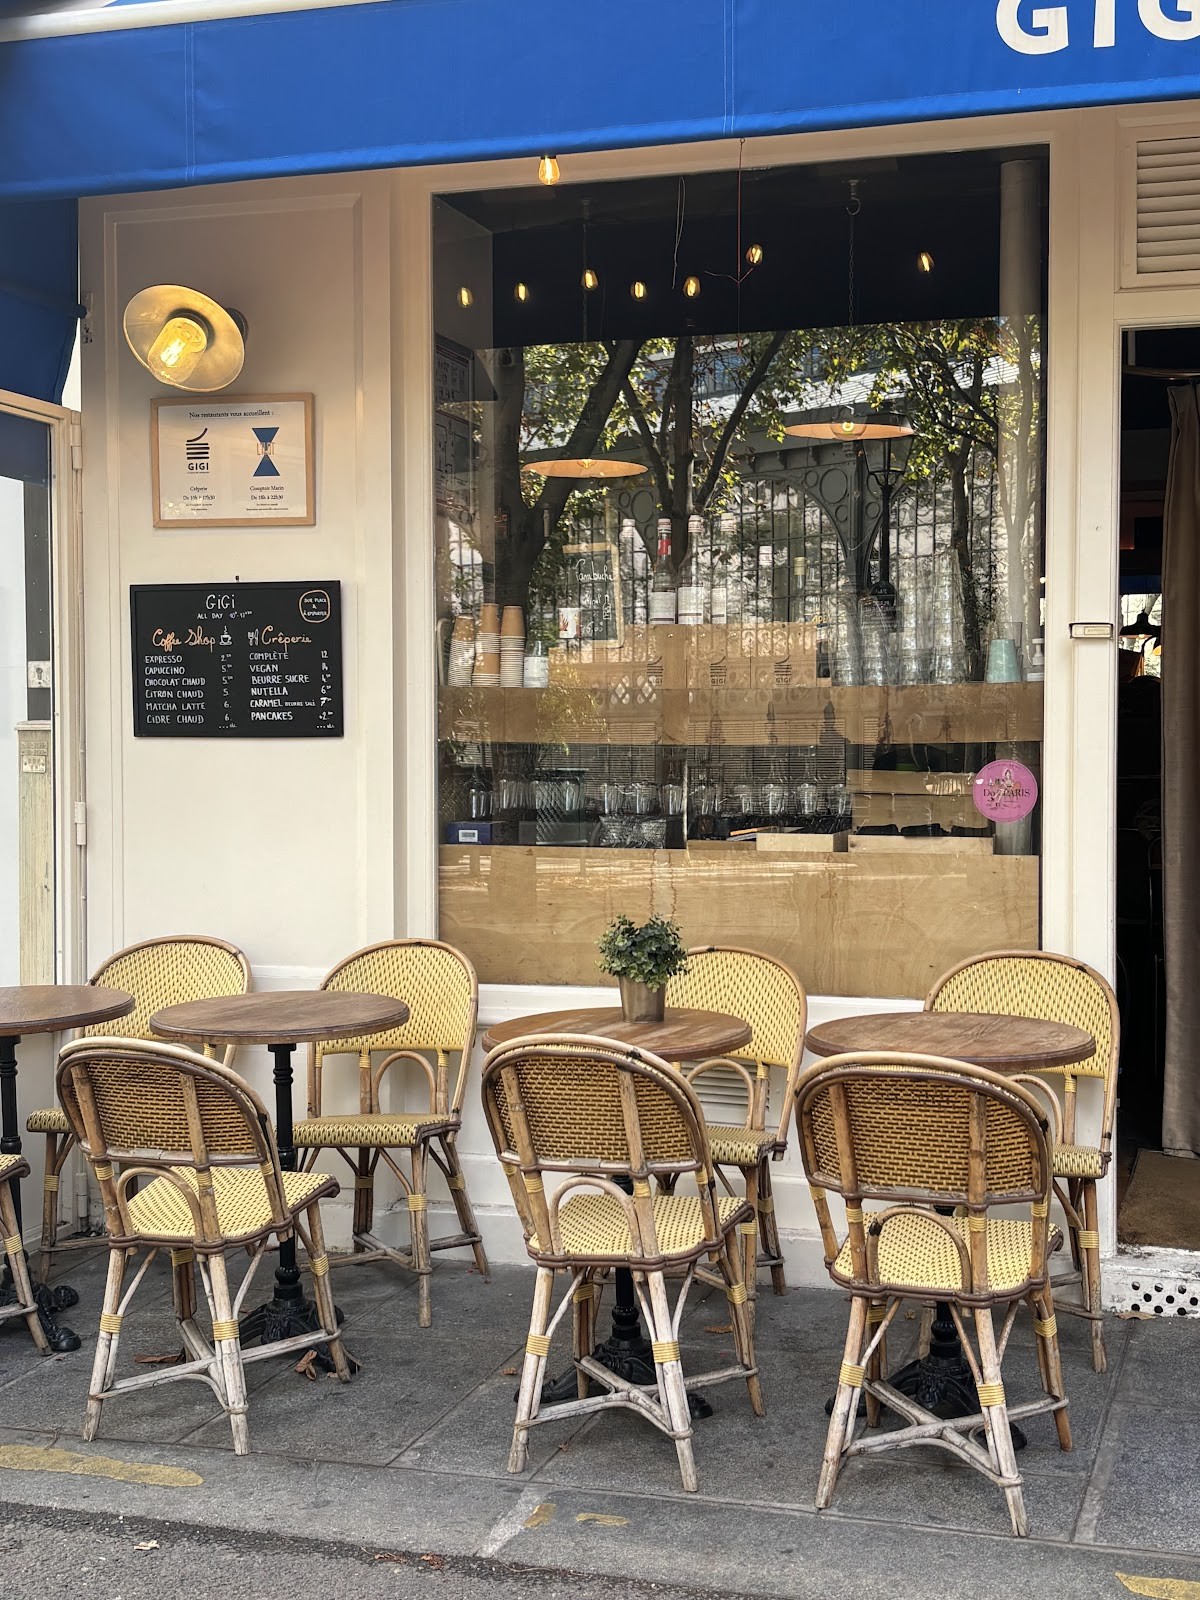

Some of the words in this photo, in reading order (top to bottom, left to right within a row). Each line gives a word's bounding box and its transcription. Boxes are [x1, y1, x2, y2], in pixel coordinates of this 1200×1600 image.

[188, 462, 209, 471] GIGI
[152, 628, 182, 652] Coffee
[185, 625, 216, 653] Shop
[261, 625, 312, 653] Crêperie
[144, 655, 183, 664] EXPRESSO
[249, 651, 289, 660] COMPLÈTE
[144, 666, 186, 675] CAPUCCINO
[249, 664, 279, 673] VEGAN
[144, 678, 180, 687] CHOCOLAT
[181, 677, 206, 686] CHAUD
[251, 674, 282, 685] BEURRE
[285, 674, 310, 683] SUCRE
[176, 690, 204, 699] CHAUD
[250, 686, 289, 696] NUTELLA
[145, 702, 178, 711] MATCHA
[181, 702, 206, 711] LATTE
[250, 698, 283, 708] CARAMEL
[176, 715, 205, 724] CHAUD
[250, 711, 294, 721] PANCAKES
